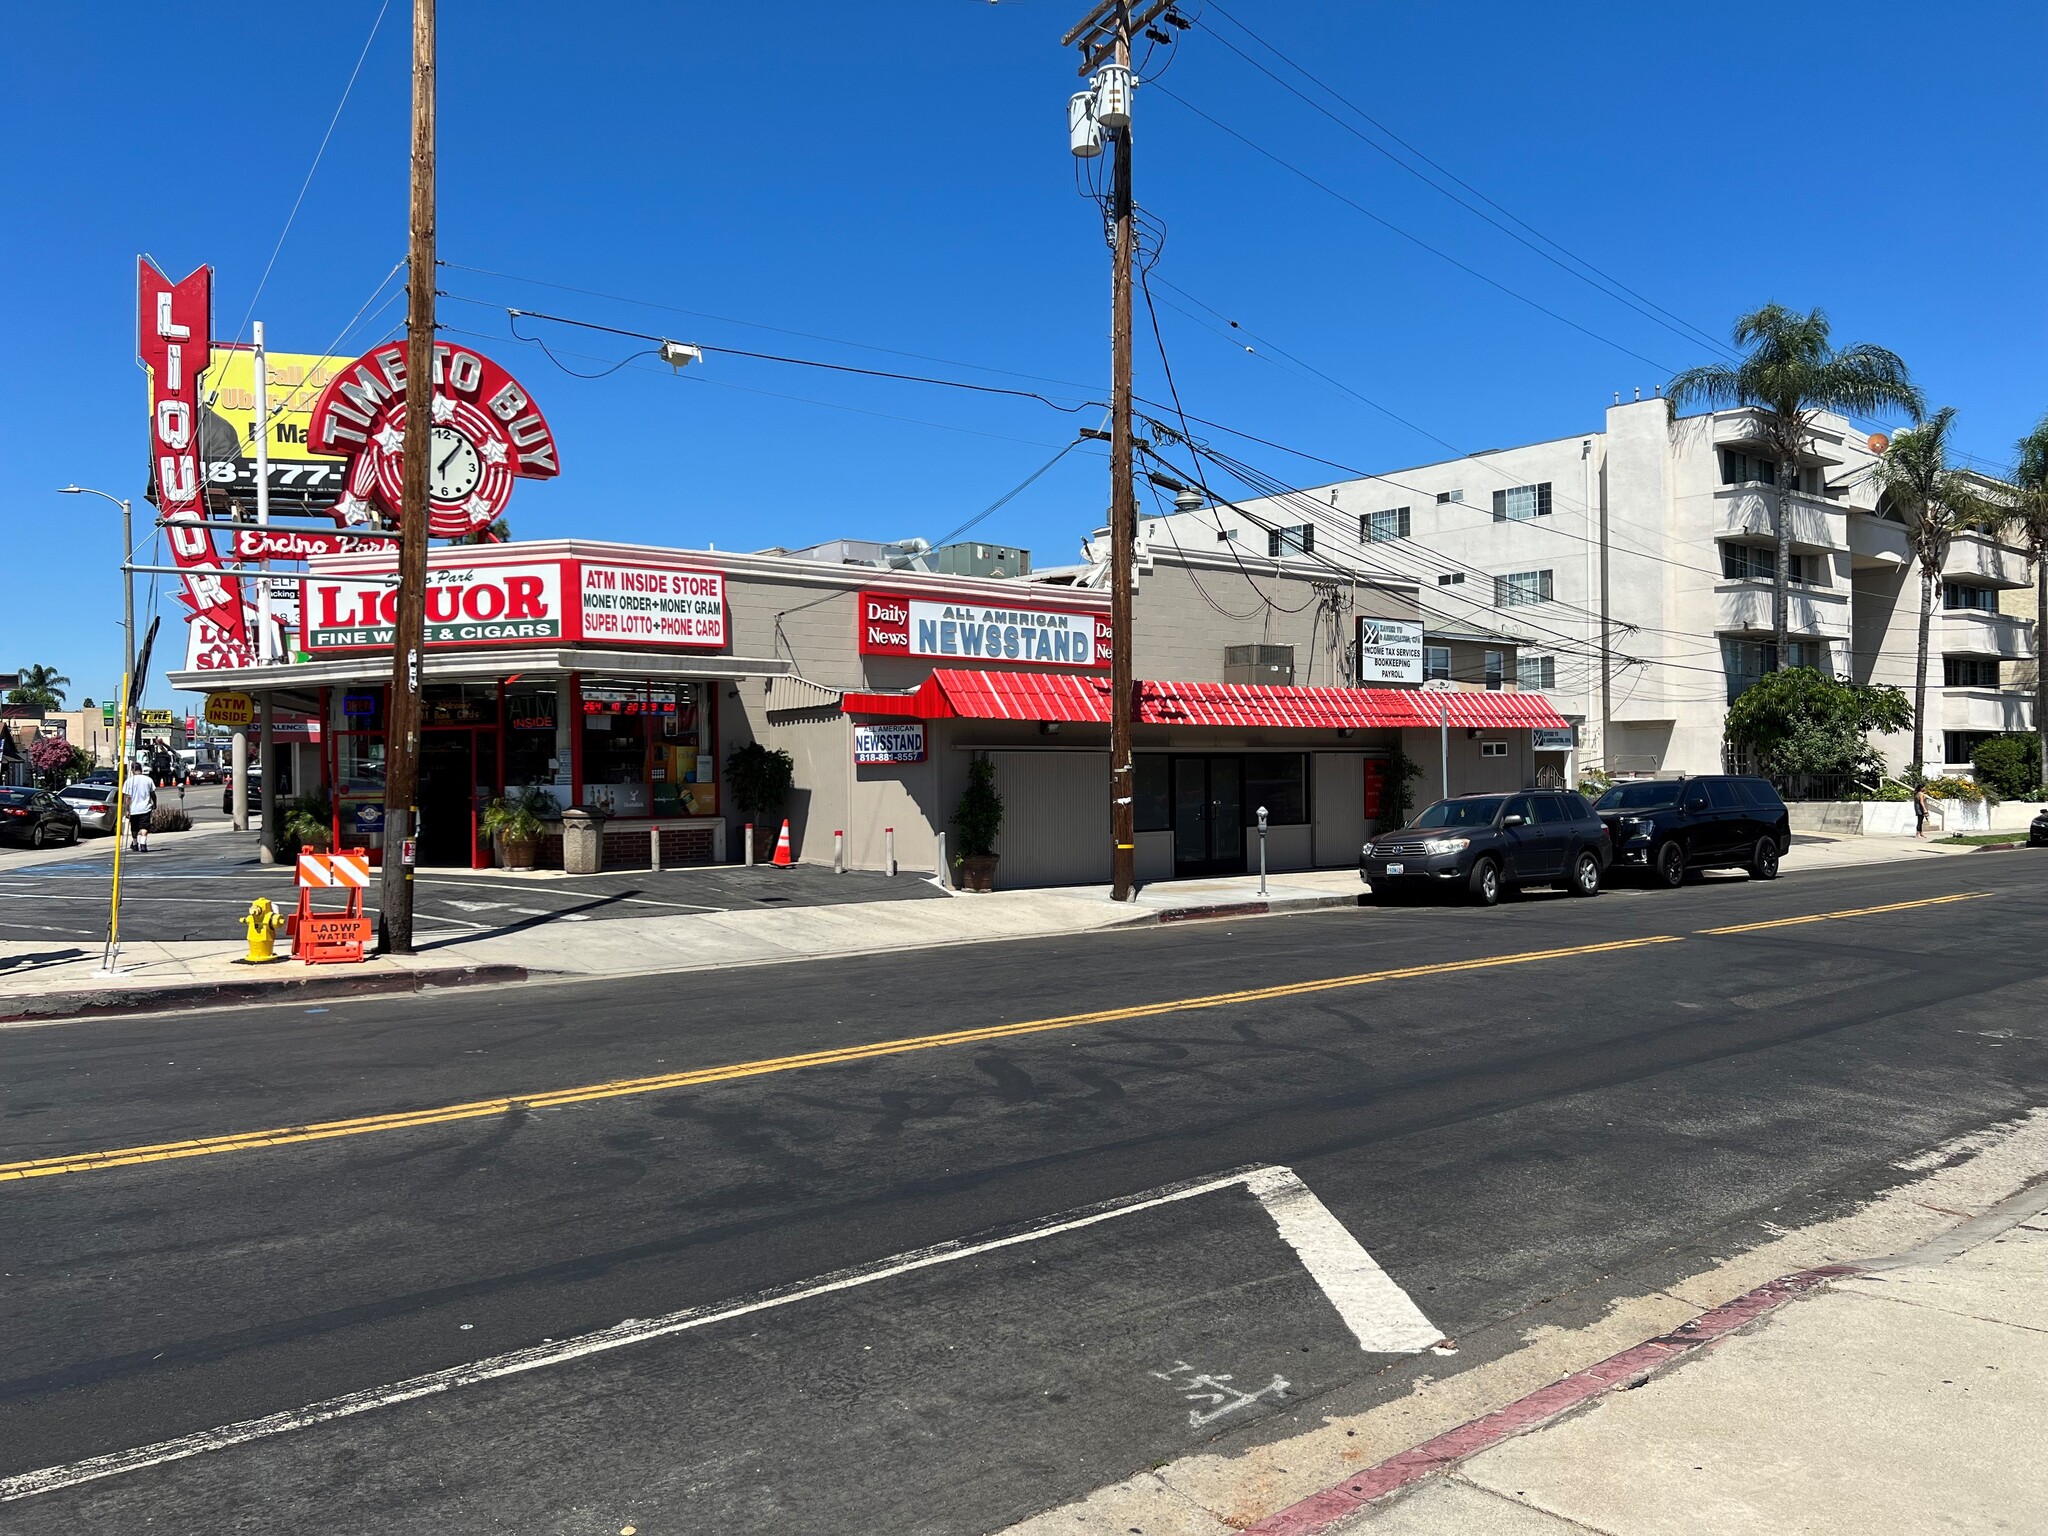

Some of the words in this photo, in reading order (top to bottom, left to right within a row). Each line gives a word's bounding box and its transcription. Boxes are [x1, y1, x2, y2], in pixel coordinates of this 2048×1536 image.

[322, 348, 407, 444] TIME
[432, 346, 482, 393] TO
[487, 380, 556, 471] BUY
[435, 430, 451, 440] 12
[469, 463, 476, 473] 3
[441, 487, 449, 497] 6
[437, 569, 474, 583] Park
[586, 569, 615, 590] ATM
[621, 572, 668, 593] INSIDE
[672, 576, 718, 597] STORE
[583, 593, 618, 609] MONEY
[695, 600, 721, 615] GRAM
[867, 603, 908, 626] Daily
[943, 606, 978, 621] ALL
[982, 609, 1069, 629] AMERICAN
[585, 612, 618, 632] SUPER
[621, 614, 651, 634] LOTTO
[661, 617, 692, 636] PHONE
[695, 619, 721, 637] CARD
[317, 631, 367, 645] FINE
[373, 629, 433, 643] WE
[439, 627, 454, 640] &
[460, 622, 551, 638] CIGARS
[868, 627, 908, 646] News
[918, 618, 1089, 662] NEWSSTAND
[1365, 646, 1384, 655] INCOME
[1386, 647, 1395, 656] TAX
[1397, 648, 1420, 657] SERVICES
[1375, 658, 1411, 668] BOOKKEEPING
[1382, 670, 1404, 678] PAYROLL
[212, 698, 245, 710] ATM
[210, 711, 247, 722] INSIDE
[513, 717, 553, 728] INSIDE
[856, 734, 922, 751] NEWSSTAND
[860, 752, 918, 762] 818-881-8557
[311, 923, 361, 933] LADWP
